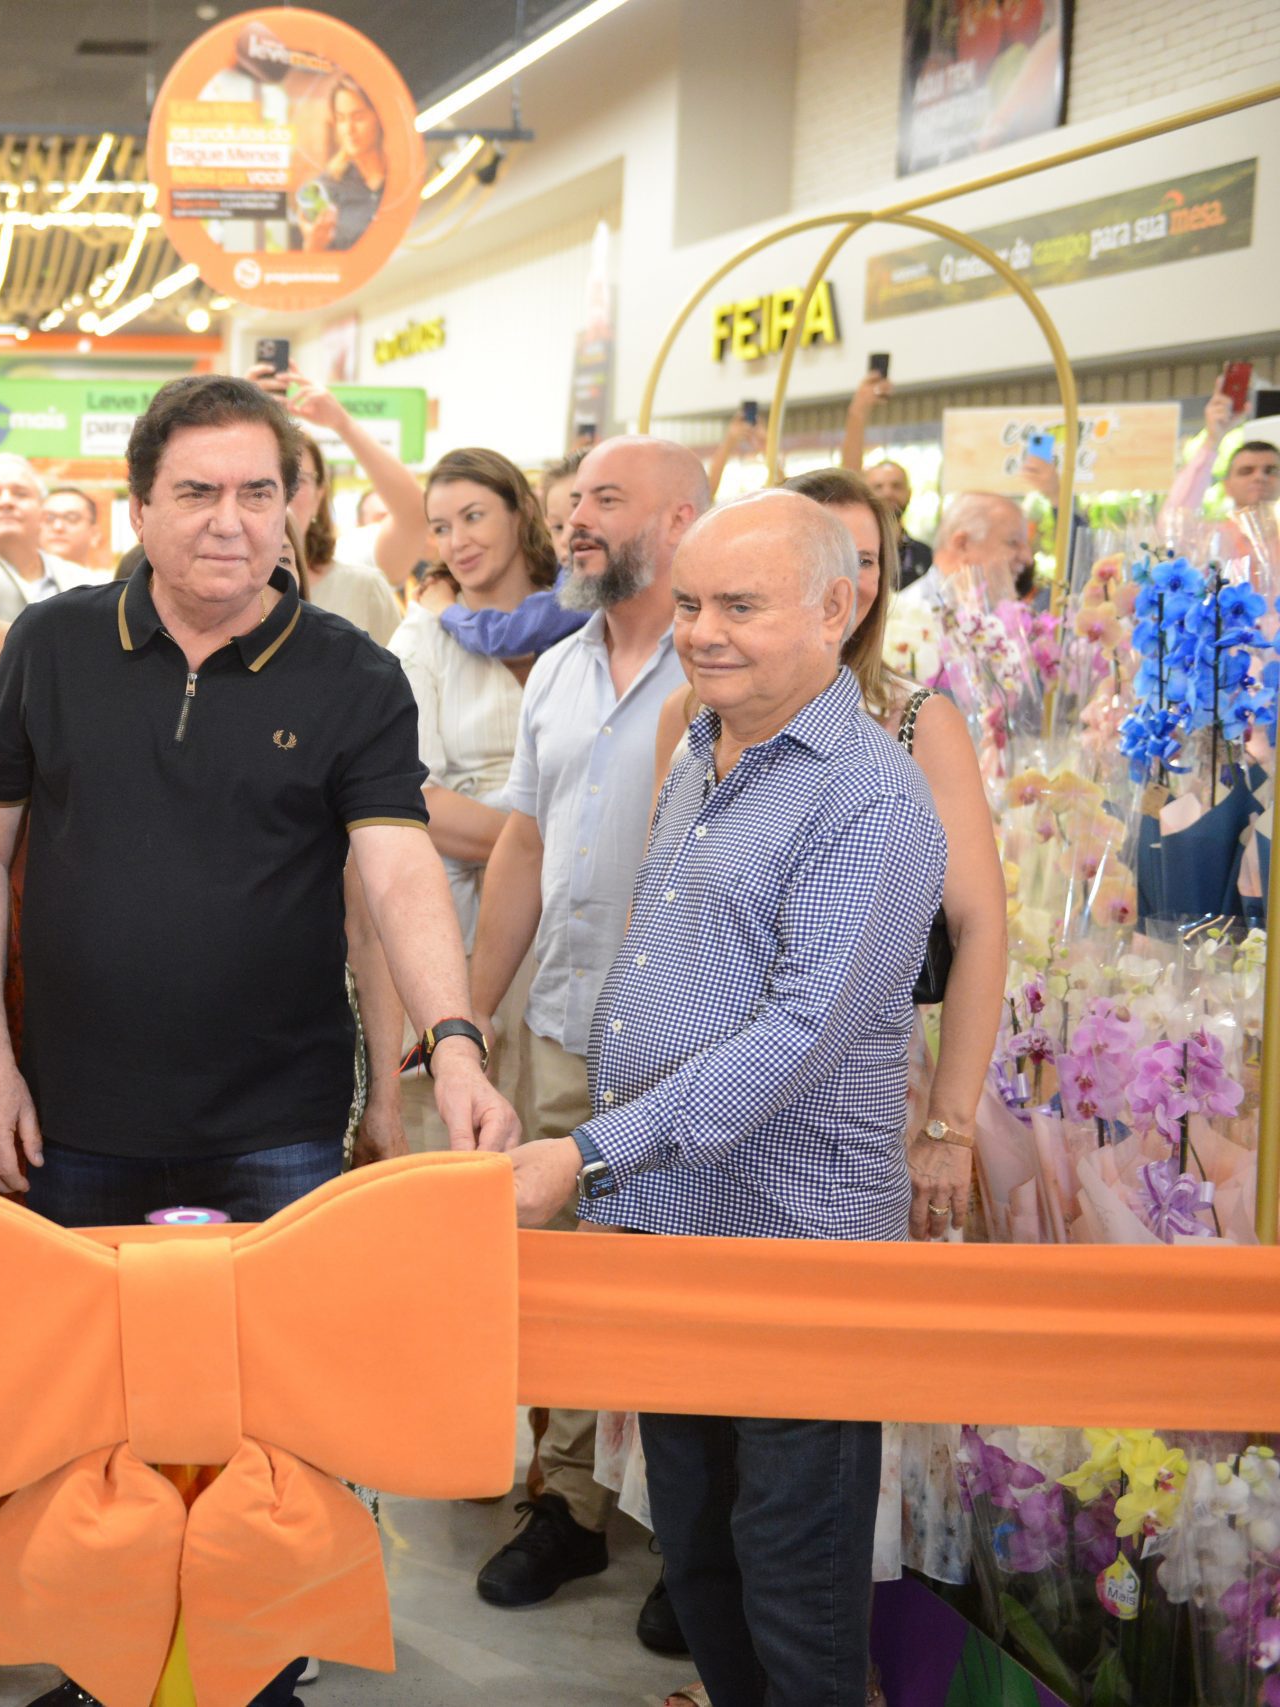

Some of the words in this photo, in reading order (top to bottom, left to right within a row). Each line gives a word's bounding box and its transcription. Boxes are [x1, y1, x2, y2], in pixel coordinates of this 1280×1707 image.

[173, 147, 222, 166] Pague
[227, 147, 280, 161] Menos
[940, 254, 954, 284] O
[1010, 238, 1032, 270] do
[1033, 233, 1090, 266] campo
[1089, 222, 1132, 260] para
[1134, 213, 1167, 243] sua
[712, 280, 838, 361] FEIRA
[86, 392, 137, 410] Leve
[1107, 1586, 1137, 1606] Mais
